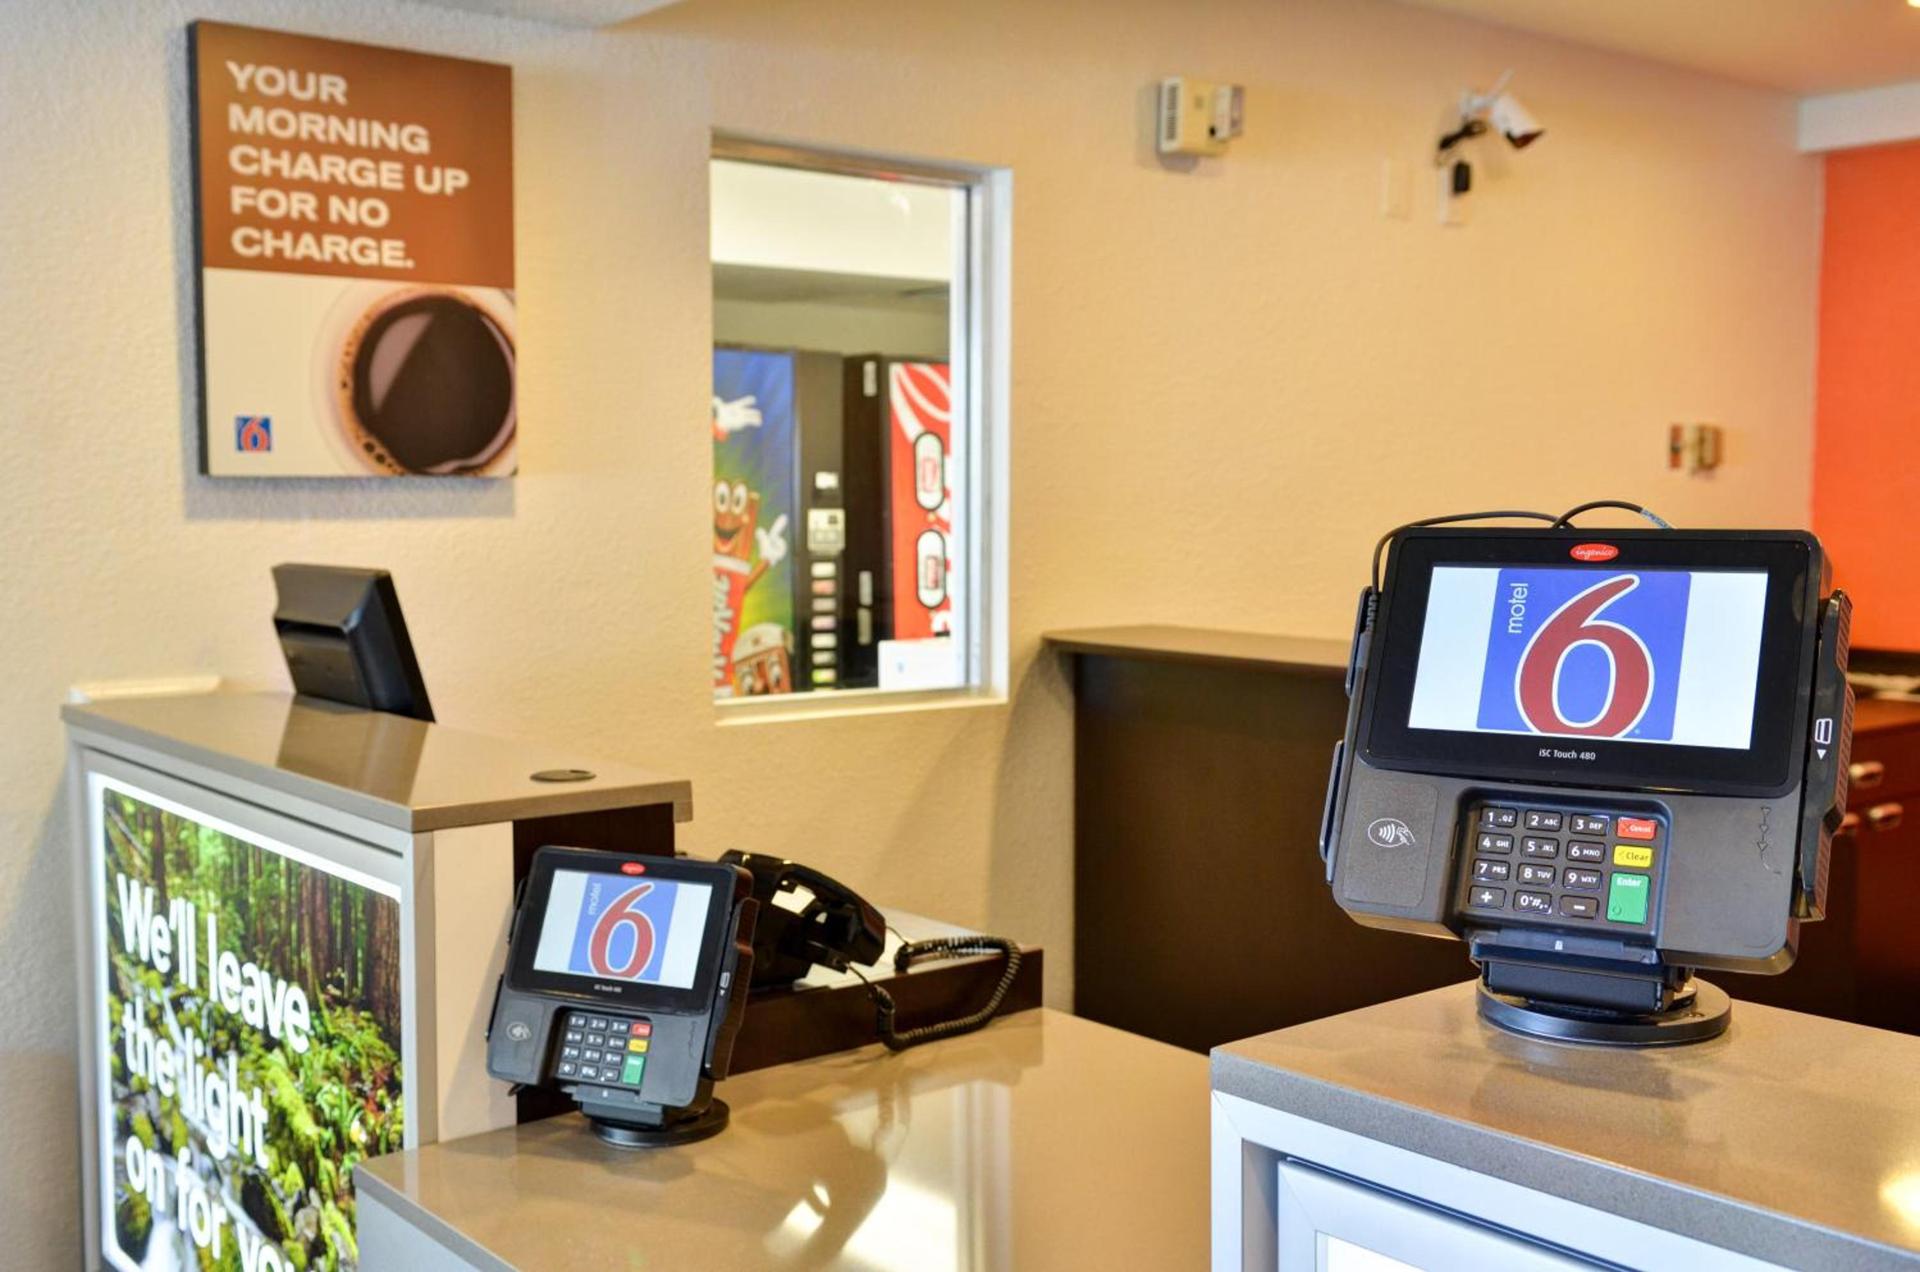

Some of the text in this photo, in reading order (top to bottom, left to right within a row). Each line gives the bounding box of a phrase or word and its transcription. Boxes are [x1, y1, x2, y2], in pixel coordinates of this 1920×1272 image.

[226, 61, 347, 104] YOUR
[228, 104, 430, 154] MORNING
[229, 146, 469, 196] CHARGE UP
[231, 186, 389, 228] FOR NO
[232, 227, 414, 269] CHARGE.
[240, 417, 271, 453] 6
[1508, 583, 1528, 634] motel
[1515, 574, 1655, 738] 6
[1553, 749, 1577, 759] Touch
[1579, 752, 1596, 760] 480
[1487, 812, 1495, 823] 1
[1531, 815, 1539, 826] 2
[1576, 819, 1603, 830] 3 DEF
[1482, 837, 1510, 848] 4 GHI
[1527, 840, 1536, 851] 5
[1571, 845, 1600, 857] 6 MNO
[1479, 863, 1488, 874] 7
[1626, 851, 1649, 862] Clear
[1523, 867, 1551, 879] 8 TUV
[1568, 872, 1597, 884] 9 WXY
[1616, 877, 1642, 887] Enter
[588, 882, 655, 979] 6
[117, 873, 312, 1053] We'll leave
[122, 1001, 268, 1170] the light
[126, 1135, 166, 1213] on
[175, 1146, 227, 1260] for
